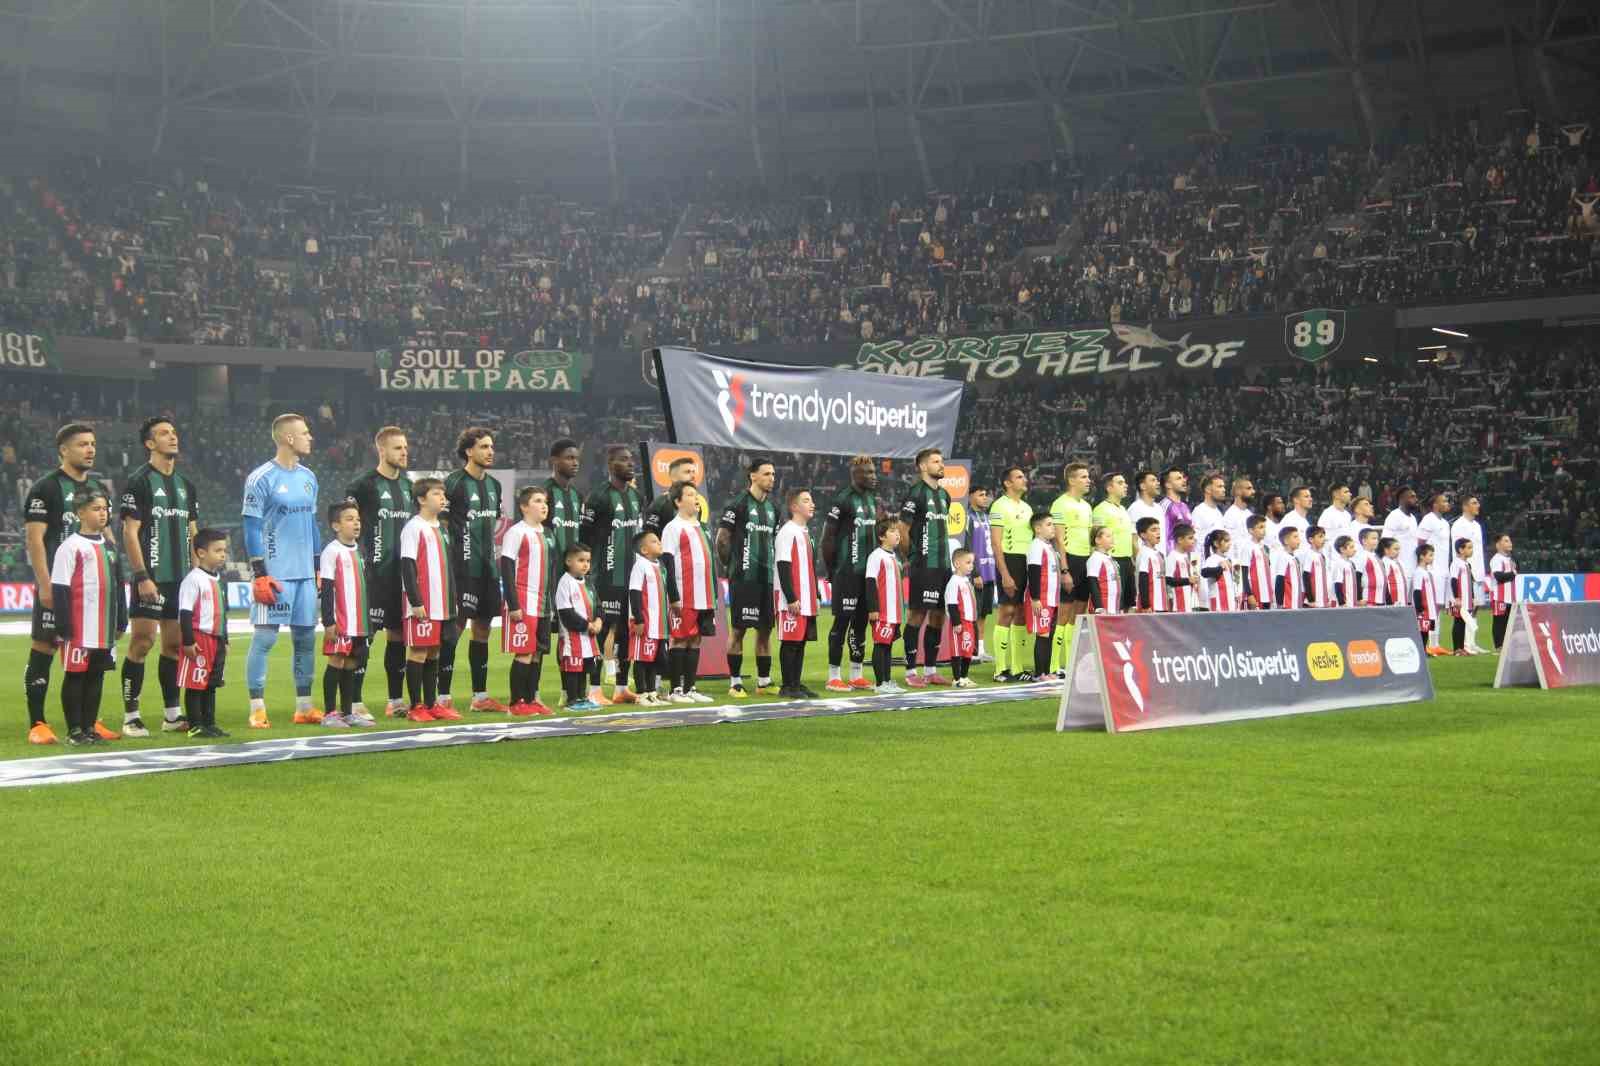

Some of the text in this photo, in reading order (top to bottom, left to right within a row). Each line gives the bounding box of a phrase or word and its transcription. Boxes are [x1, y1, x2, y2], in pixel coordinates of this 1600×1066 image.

[857, 329, 1110, 364] KÖRFEZ
[1294, 320, 1335, 347] 89
[399, 350, 466, 369] SOUL
[475, 350, 506, 368] OF
[835, 340, 1246, 382] OME TO HELL OF
[750, 383, 852, 430] trendyol
[1522, 576, 1576, 602] RAY
[416, 623, 433, 638] 07
[784, 620, 797, 632] 07
[513, 633, 529, 648] 07
[1152, 646, 1236, 687] trendyol
